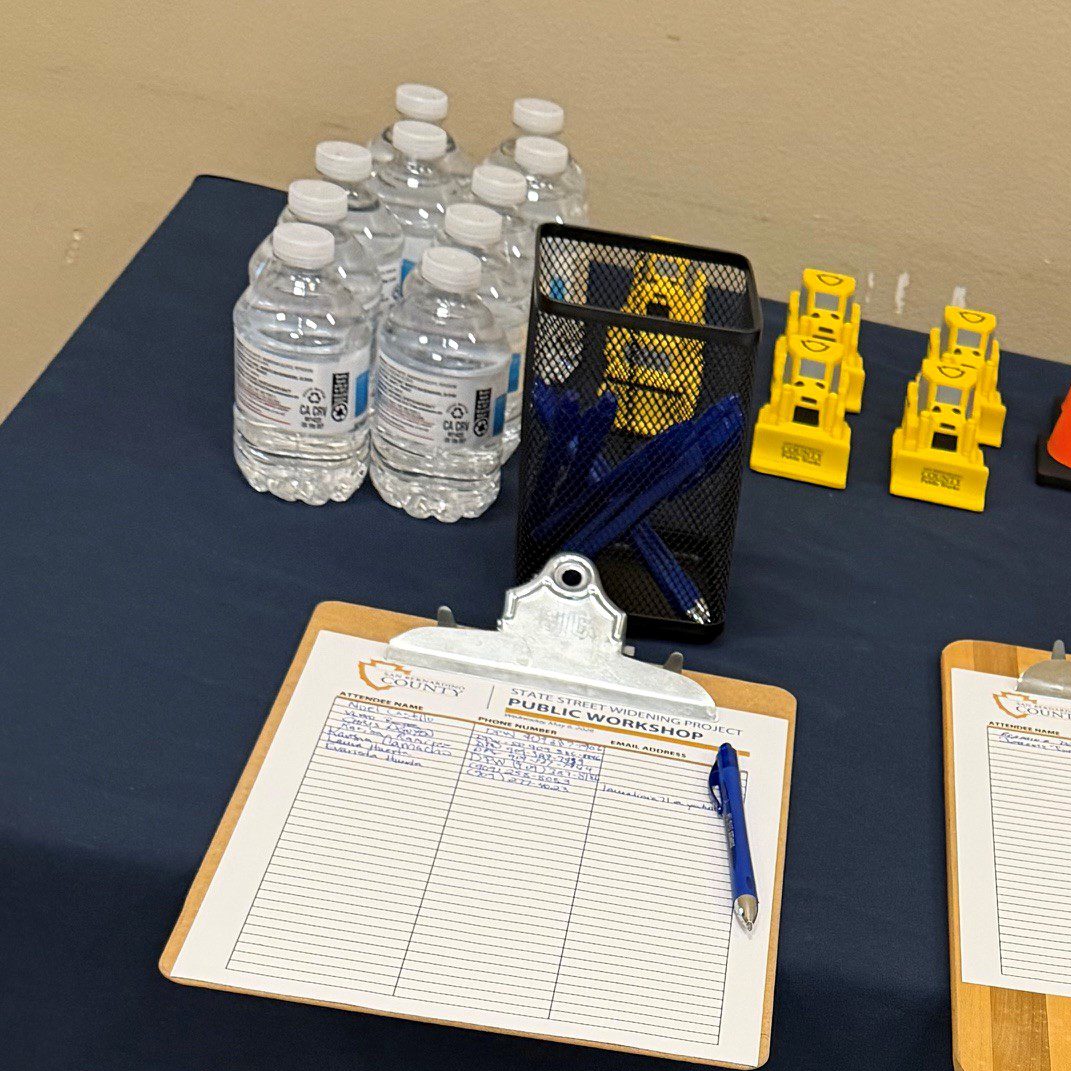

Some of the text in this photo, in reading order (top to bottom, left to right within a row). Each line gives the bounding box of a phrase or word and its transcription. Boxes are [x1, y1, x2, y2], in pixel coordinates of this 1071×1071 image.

[381, 676, 464, 697] COUNTY
[340, 691, 424, 711] ATTENDEE NAME
[508, 697, 704, 740] PUBLIC WORKSHOP
[511, 687, 744, 737] STATE STREET WIDENING PROJECT
[478, 715, 558, 735] PHONE NUMBER
[988, 720, 1032, 731] ATTENDEE
[1034, 727, 1060, 736] NAME
[610, 739, 640, 751] EMAIL
[642, 745, 687, 759] ADDRESS
